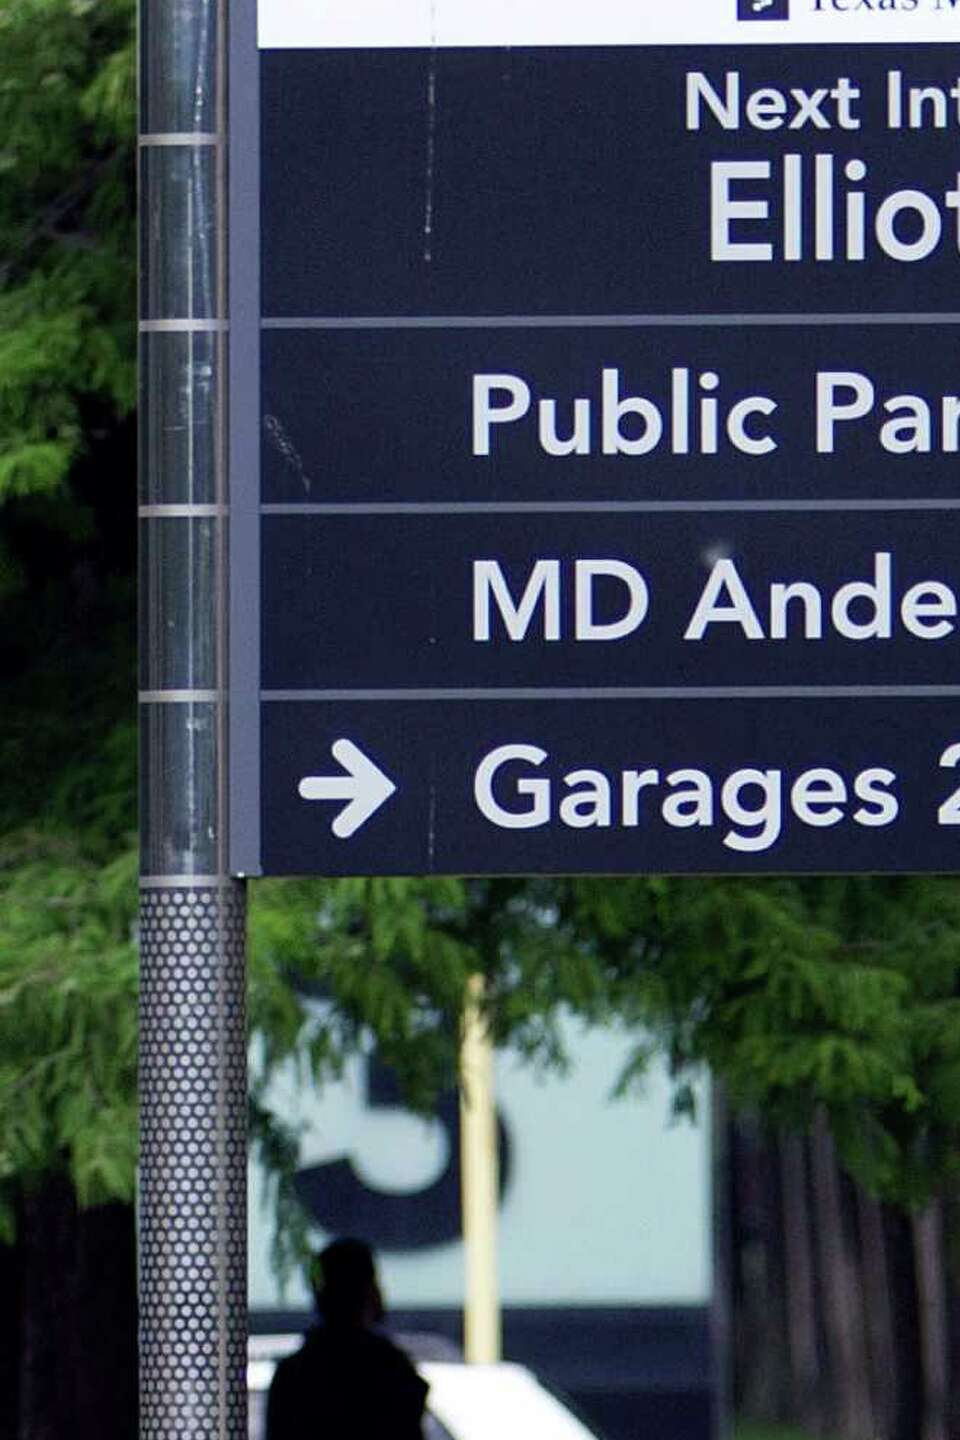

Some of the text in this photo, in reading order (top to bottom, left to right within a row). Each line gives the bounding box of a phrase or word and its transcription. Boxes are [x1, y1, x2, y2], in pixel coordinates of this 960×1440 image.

[687, 71, 860, 130] Next
[472, 367, 778, 456] Public
[473, 559, 649, 641] MD
[474, 743, 899, 852] Garages
